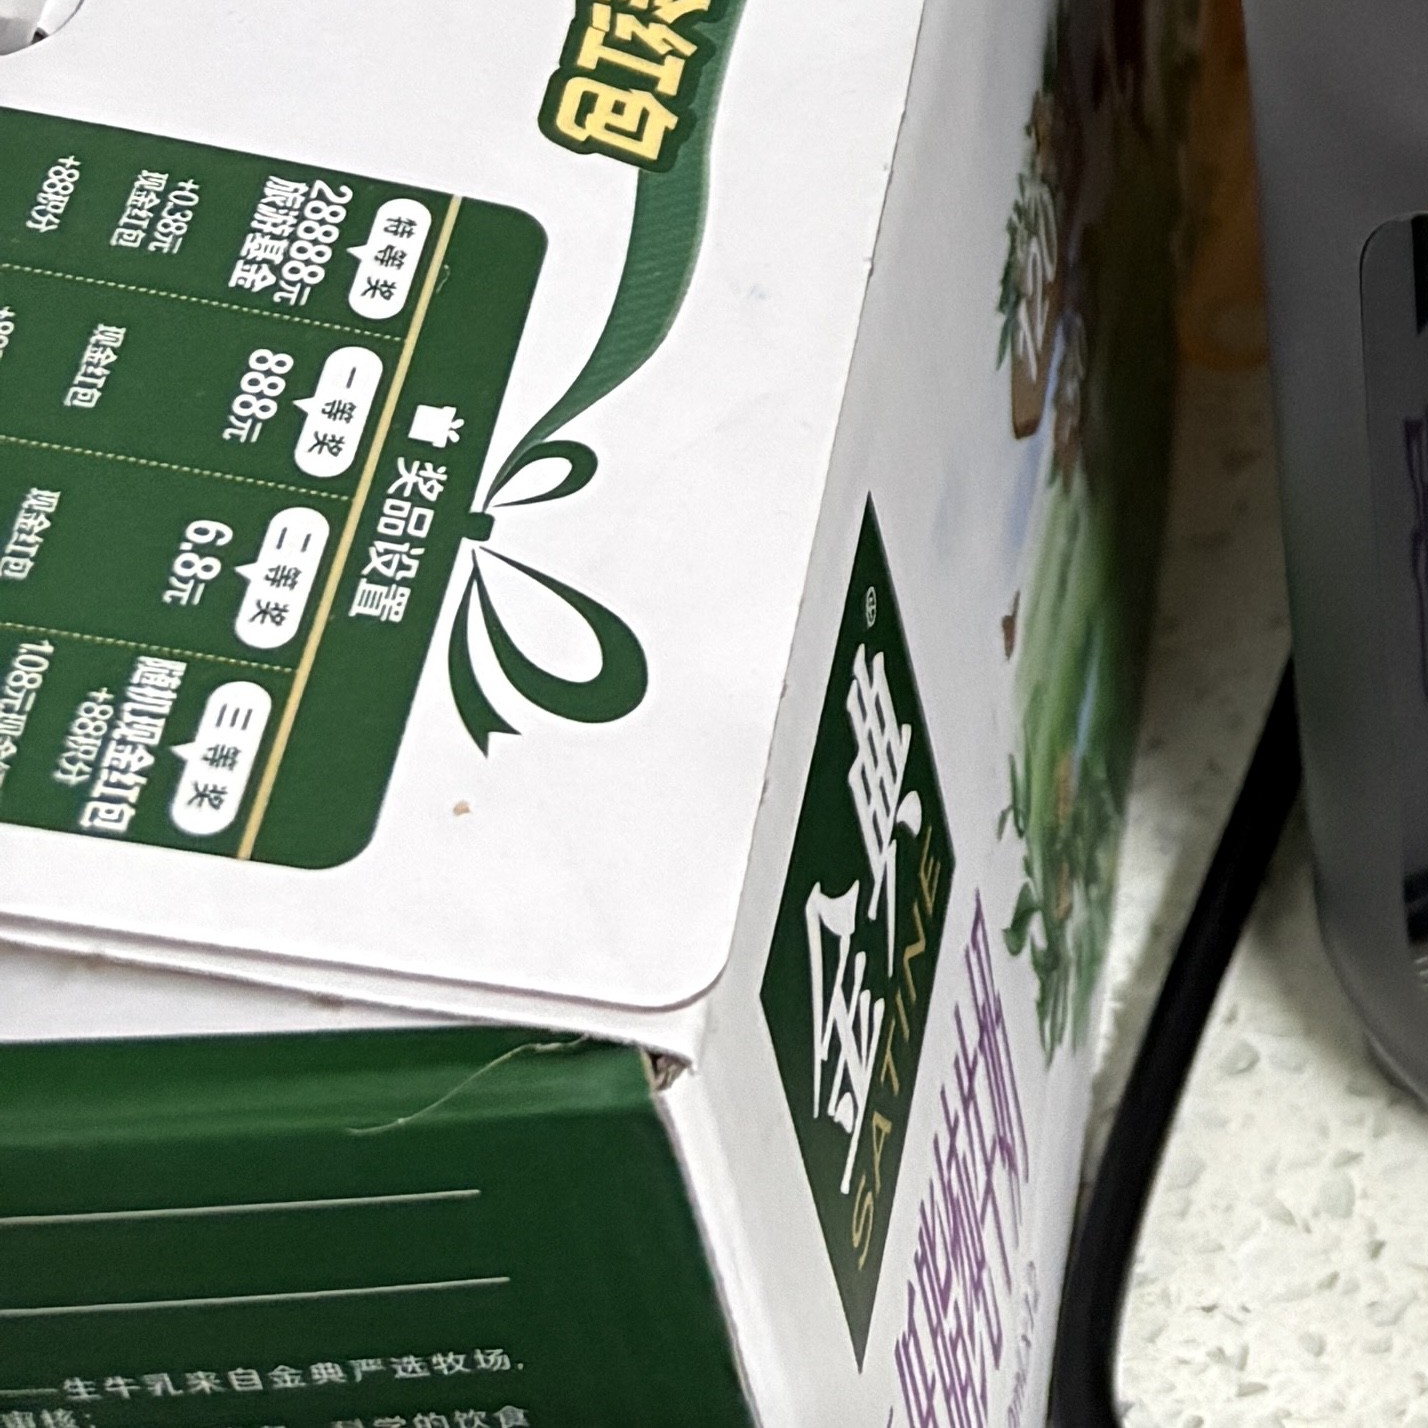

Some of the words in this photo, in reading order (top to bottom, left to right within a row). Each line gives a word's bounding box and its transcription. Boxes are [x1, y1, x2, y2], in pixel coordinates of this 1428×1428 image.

[25, 154, 82, 234] +88积分
[110, 169, 170, 249] 现金红包
[227, 174, 302, 291] 旅游基金
[273, 178, 355, 308] 28888元
[361, 216, 419, 302] 特等奖
[62, 323, 127, 410] 现金红包
[223, 347, 295, 444] 888元
[310, 364, 360, 459] 一等奖
[0, 486, 62, 583] 现金红包
[161, 518, 235, 608] 6.8元
[254, 524, 314, 628] 二等奖
[347, 456, 451, 625] 奖品设置
[52, 687, 116, 789] +88积分
[80, 654, 189, 834] 随机现金红包
[190, 702, 255, 813] 三等奖
[803, 642, 922, 1194] 金典
[850, 825, 943, 1270] SATINE
